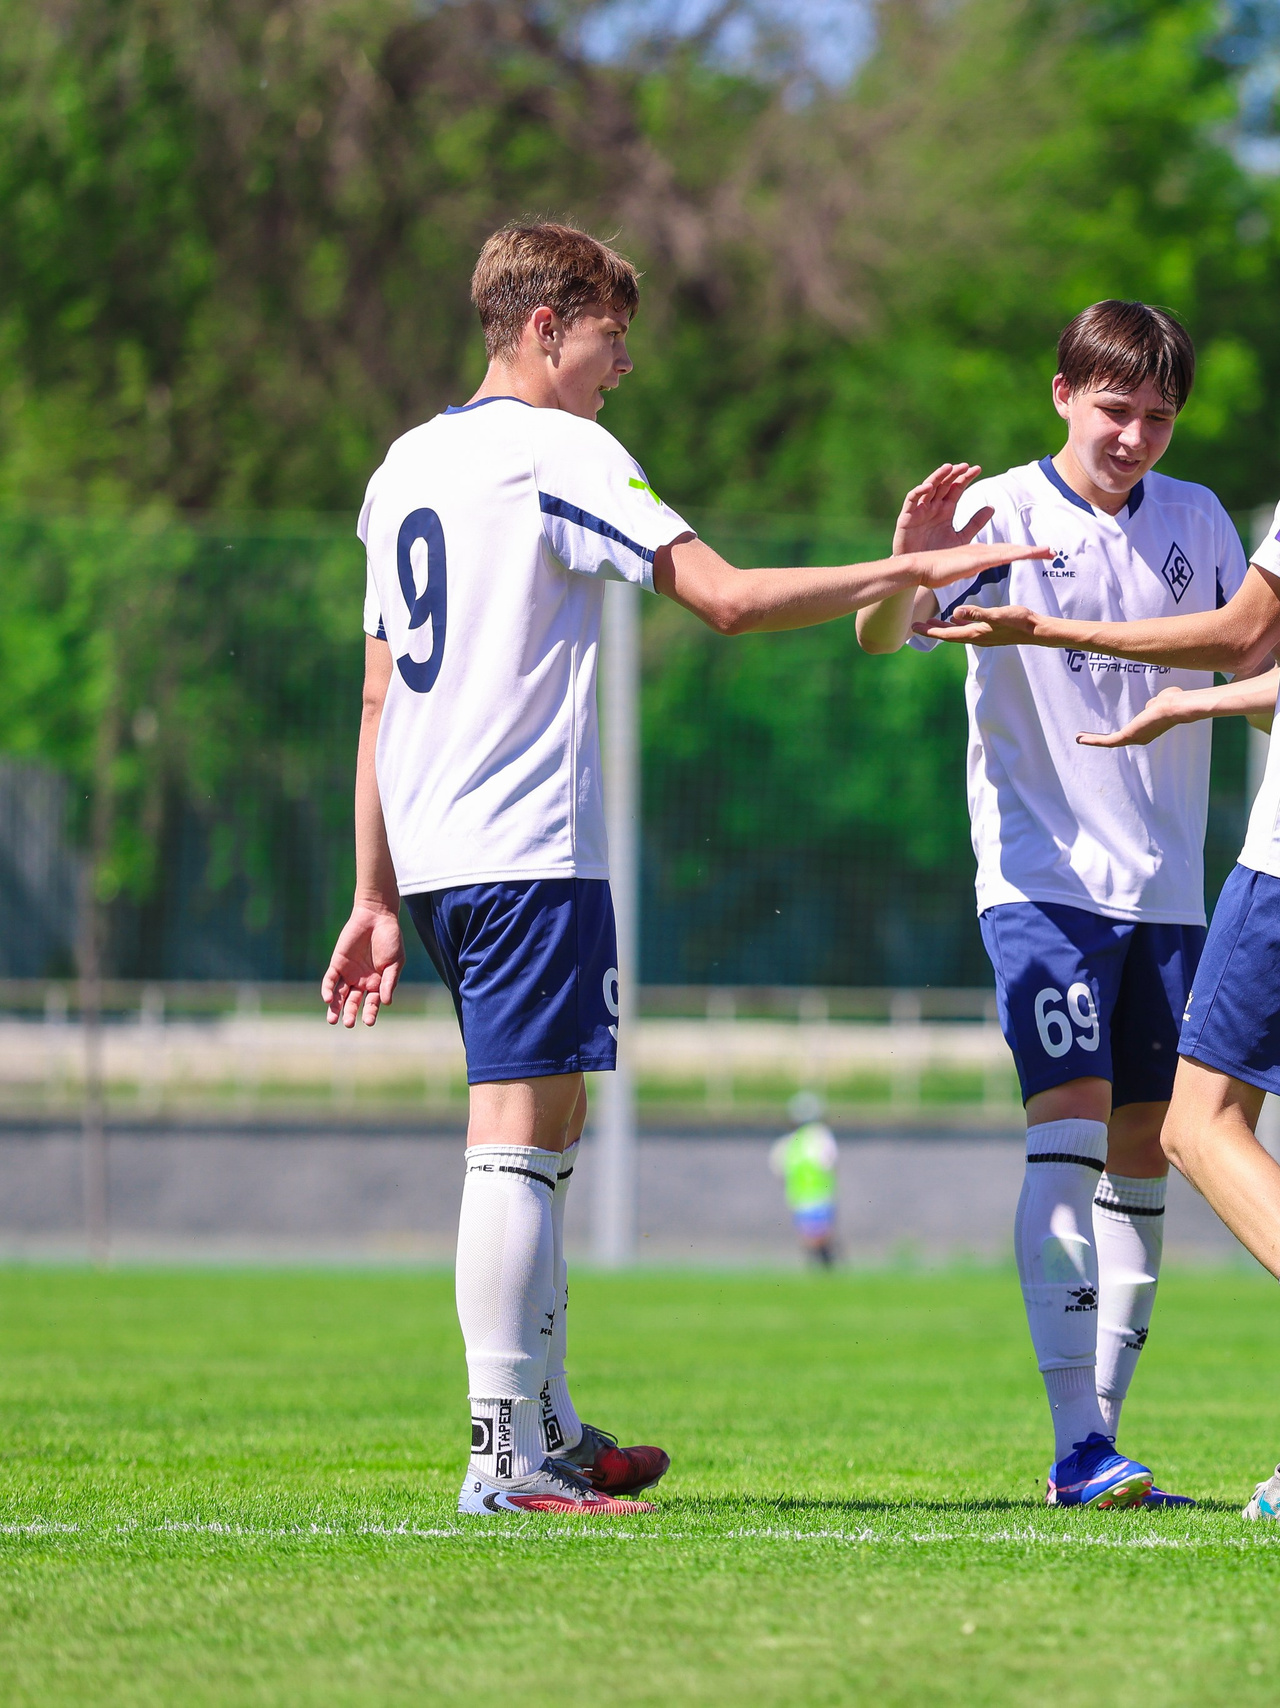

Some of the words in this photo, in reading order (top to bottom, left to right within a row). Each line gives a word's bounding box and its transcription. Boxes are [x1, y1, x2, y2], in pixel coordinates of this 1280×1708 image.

[397, 507, 447, 685] 9
[1042, 570, 1076, 578] KELME
[1034, 982, 1100, 1059] 69
